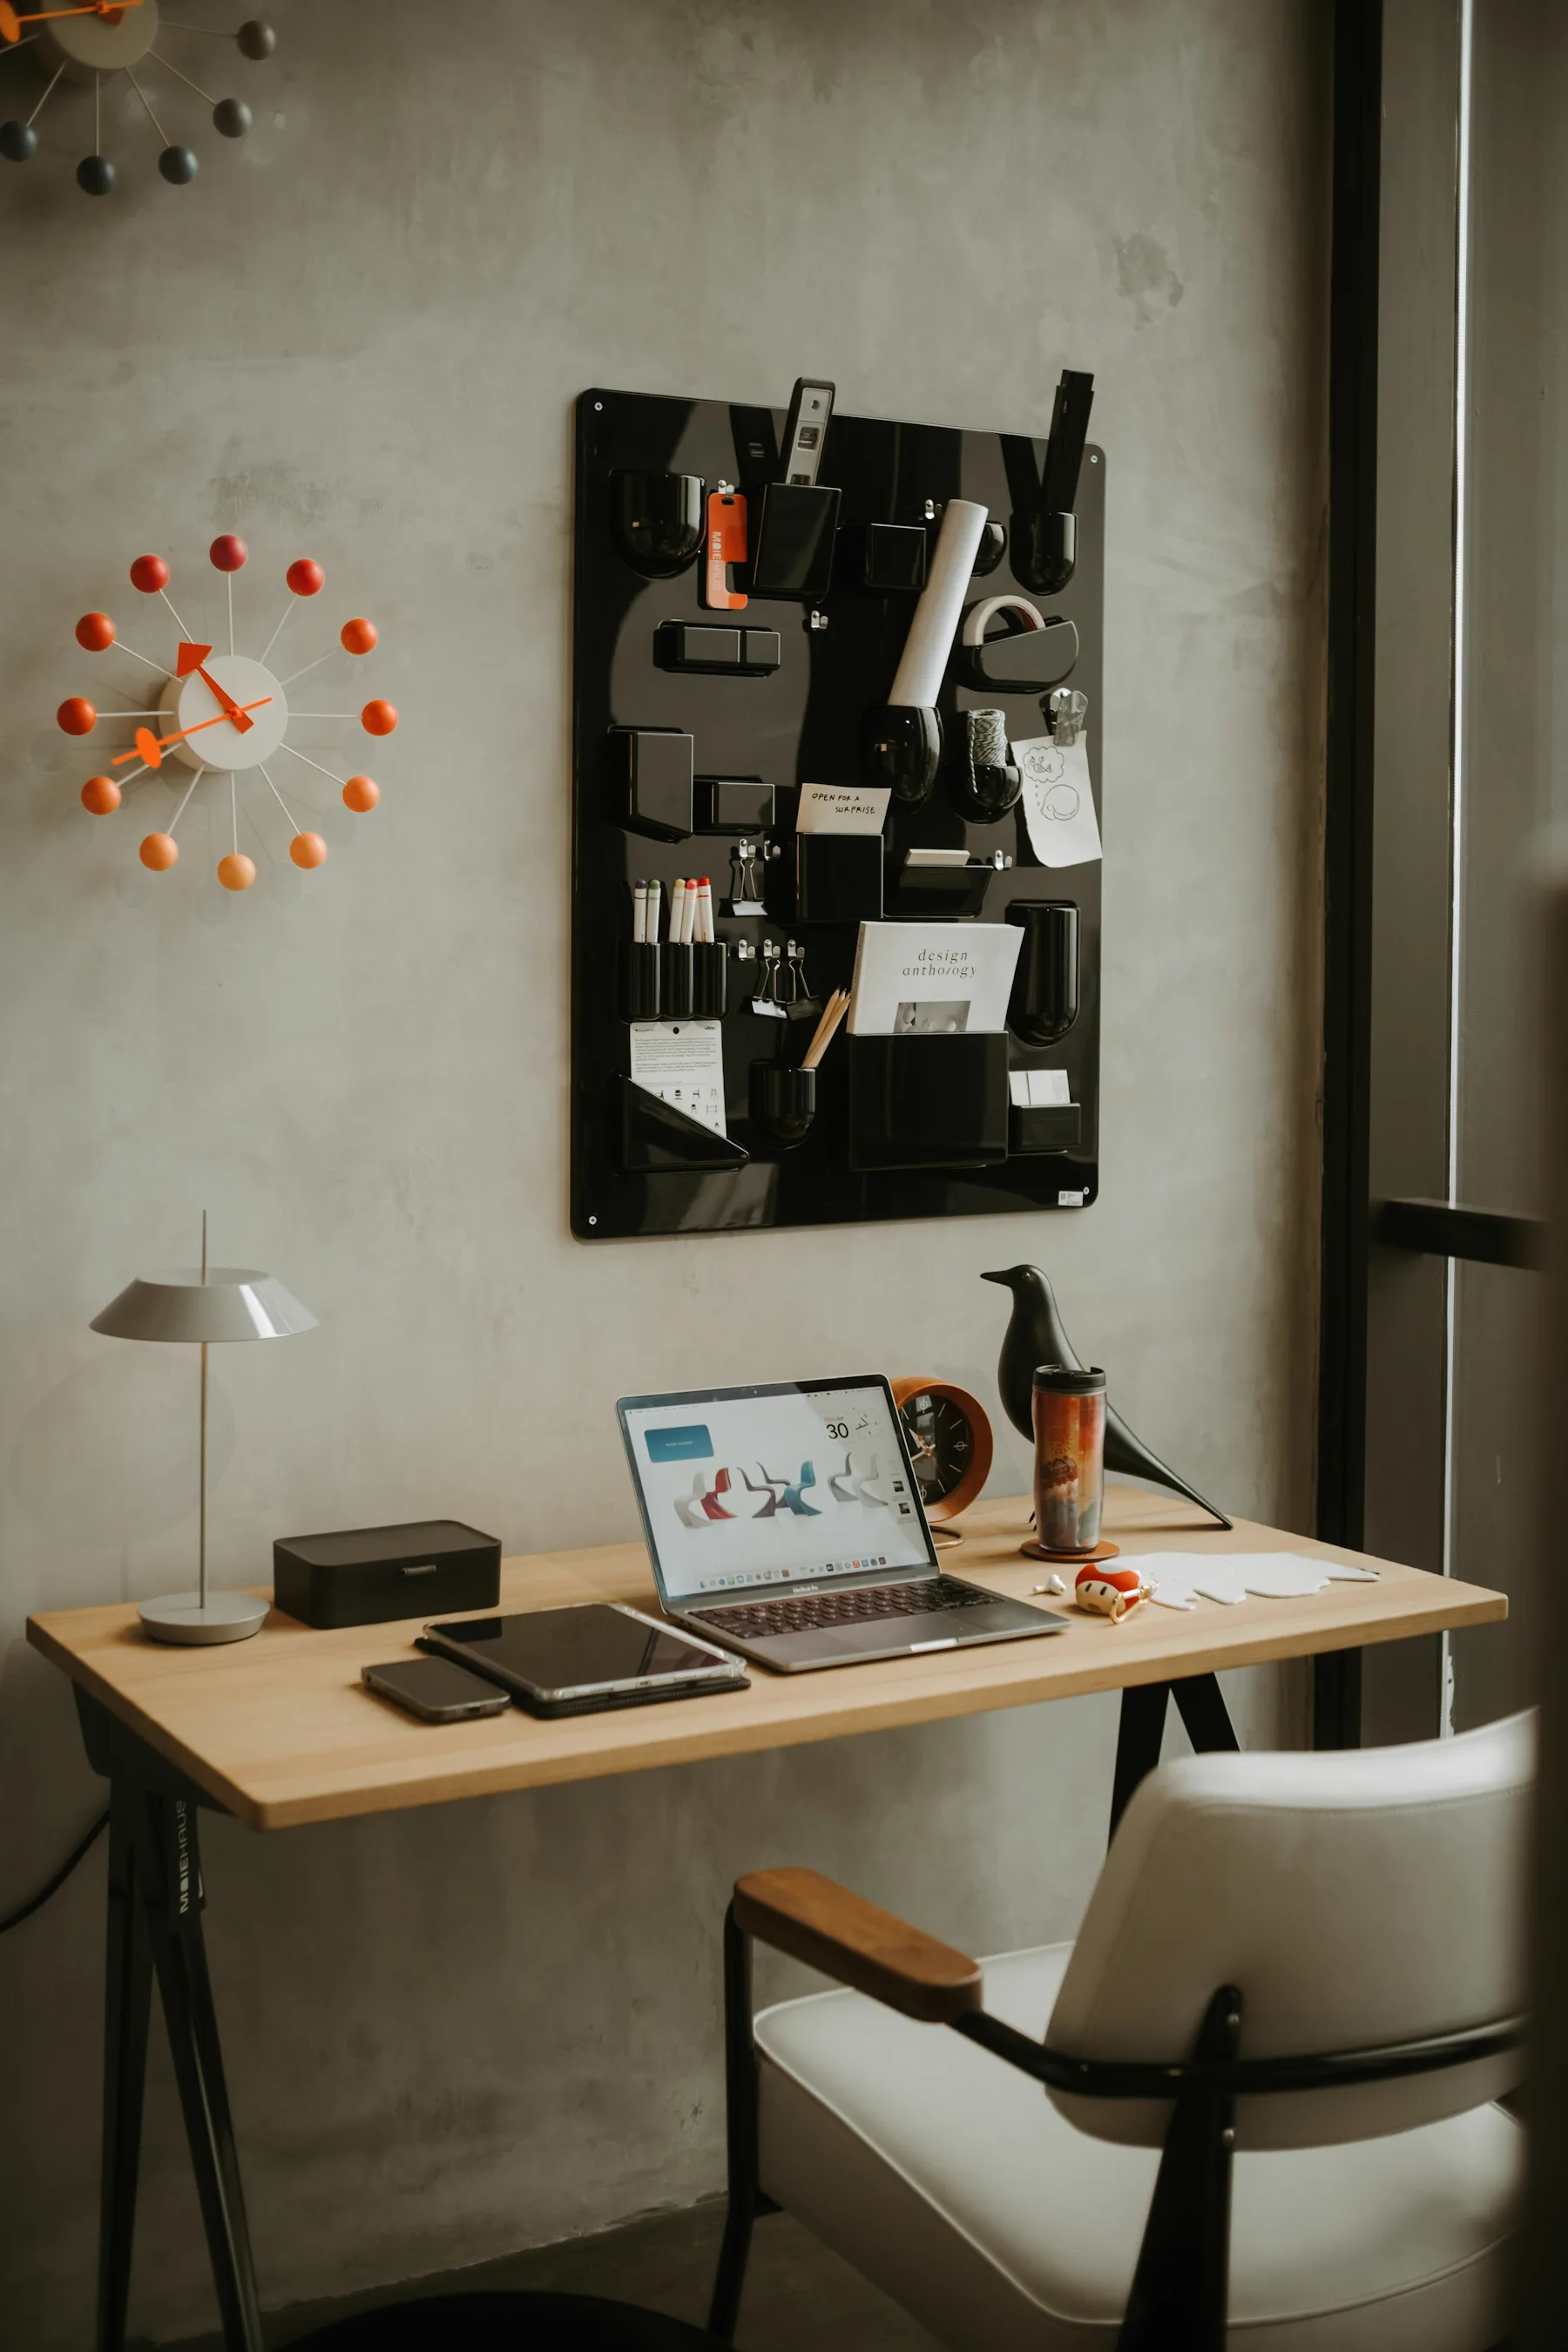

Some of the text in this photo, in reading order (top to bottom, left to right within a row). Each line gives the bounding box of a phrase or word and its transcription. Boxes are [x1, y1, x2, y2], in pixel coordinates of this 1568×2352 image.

[812, 793, 835, 801] OPEN
[835, 806, 875, 814] SURPRISE
[918, 949, 968, 964] design
[902, 963, 977, 978] anthology
[827, 1423, 848, 1439] 30
